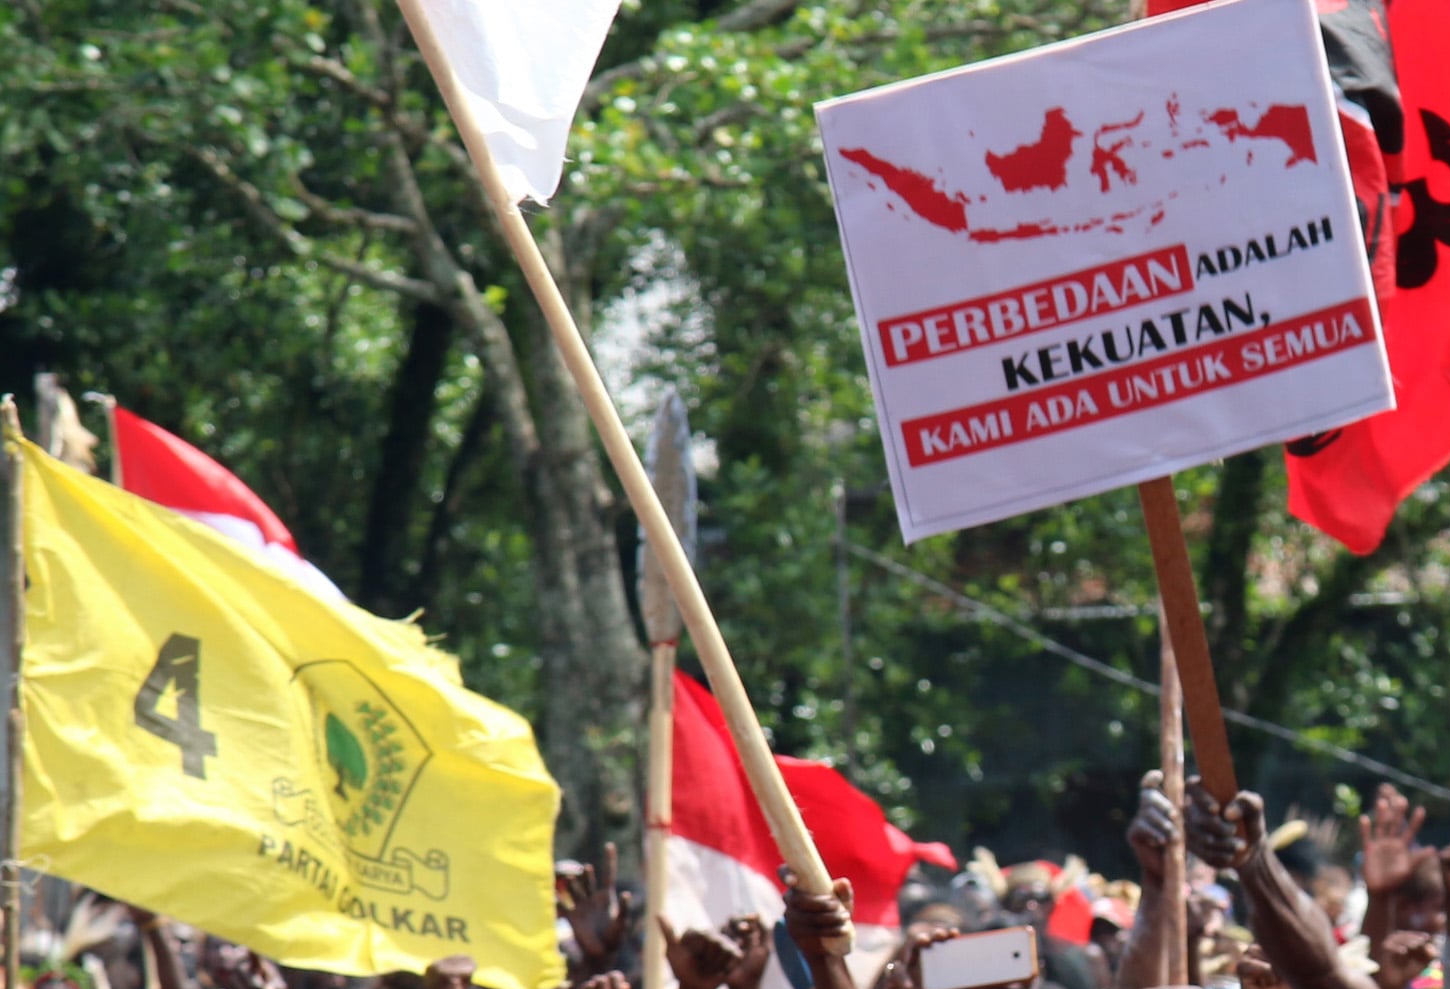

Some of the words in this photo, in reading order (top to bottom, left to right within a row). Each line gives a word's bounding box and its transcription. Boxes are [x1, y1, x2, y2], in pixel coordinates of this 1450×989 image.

[889, 255, 1182, 361] PERBEDAAN
[1195, 217, 1333, 282] ADALAH
[1001, 293, 1272, 391] KEKUATAN,
[919, 413, 1014, 456] KAMI
[1026, 388, 1098, 431] ADA
[1108, 351, 1232, 408] UNTUK
[1241, 311, 1363, 370] SEMUA
[133, 632, 218, 781] 4
[257, 833, 339, 901] PARTAI
[338, 886, 470, 944] GOLKAR
